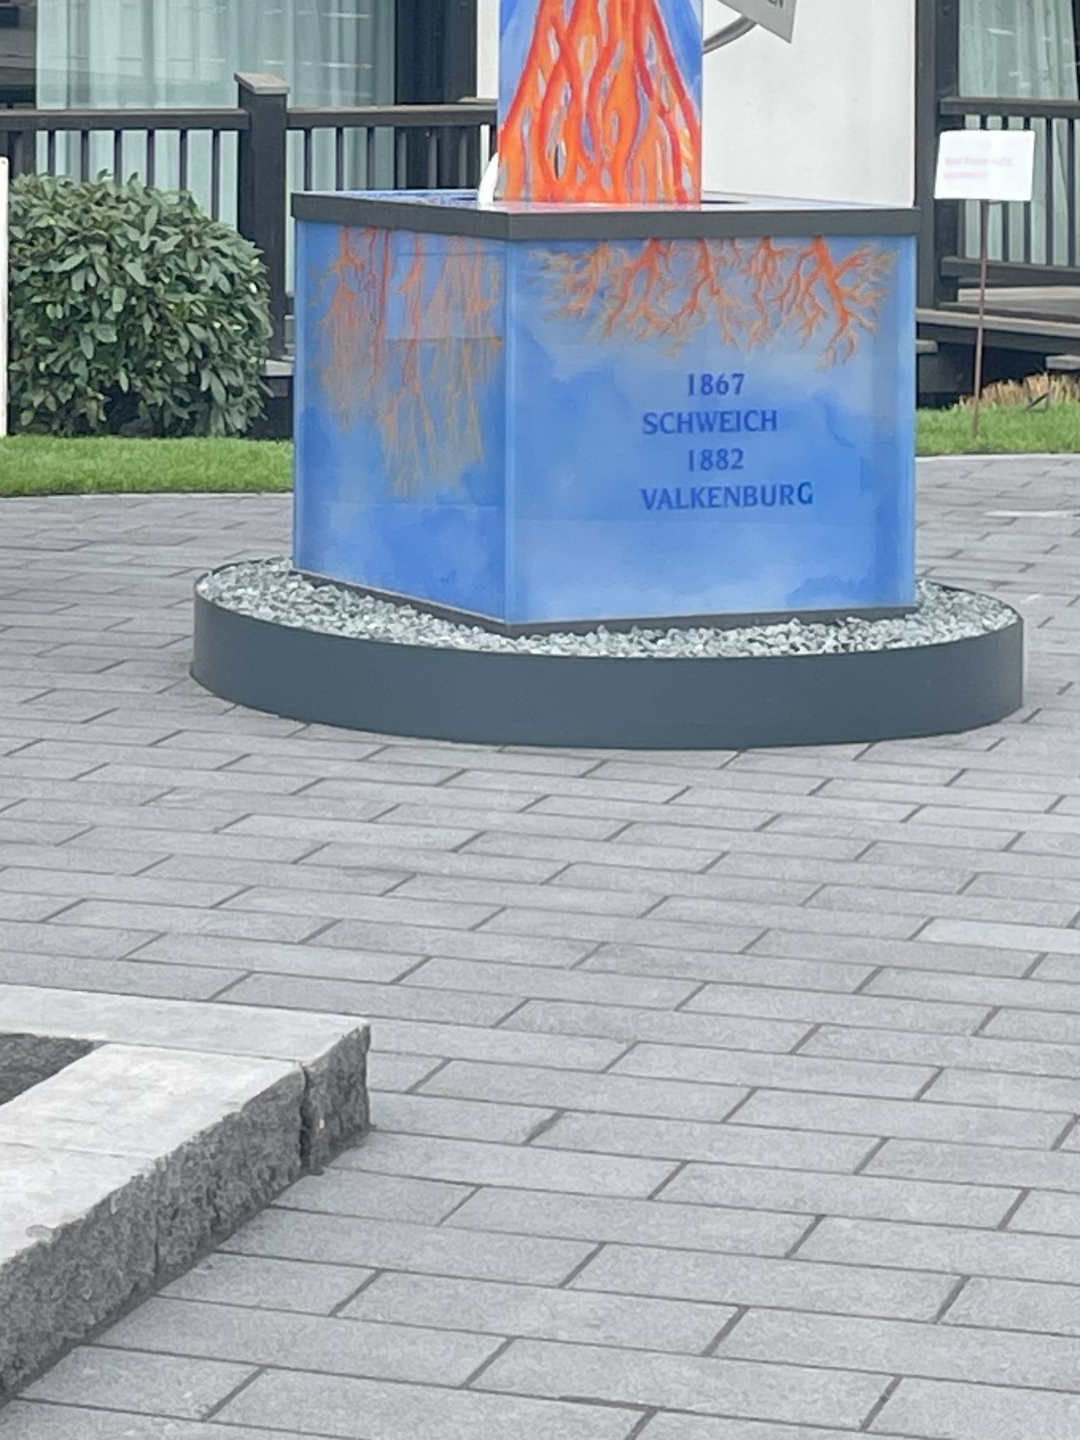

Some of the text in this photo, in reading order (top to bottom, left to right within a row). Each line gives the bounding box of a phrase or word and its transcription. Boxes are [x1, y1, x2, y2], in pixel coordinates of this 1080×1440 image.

[688, 373, 745, 396] 1867
[642, 410, 778, 435] SCHWEICH
[688, 448, 744, 471] 1882
[640, 481, 814, 510] VALKENBURG
